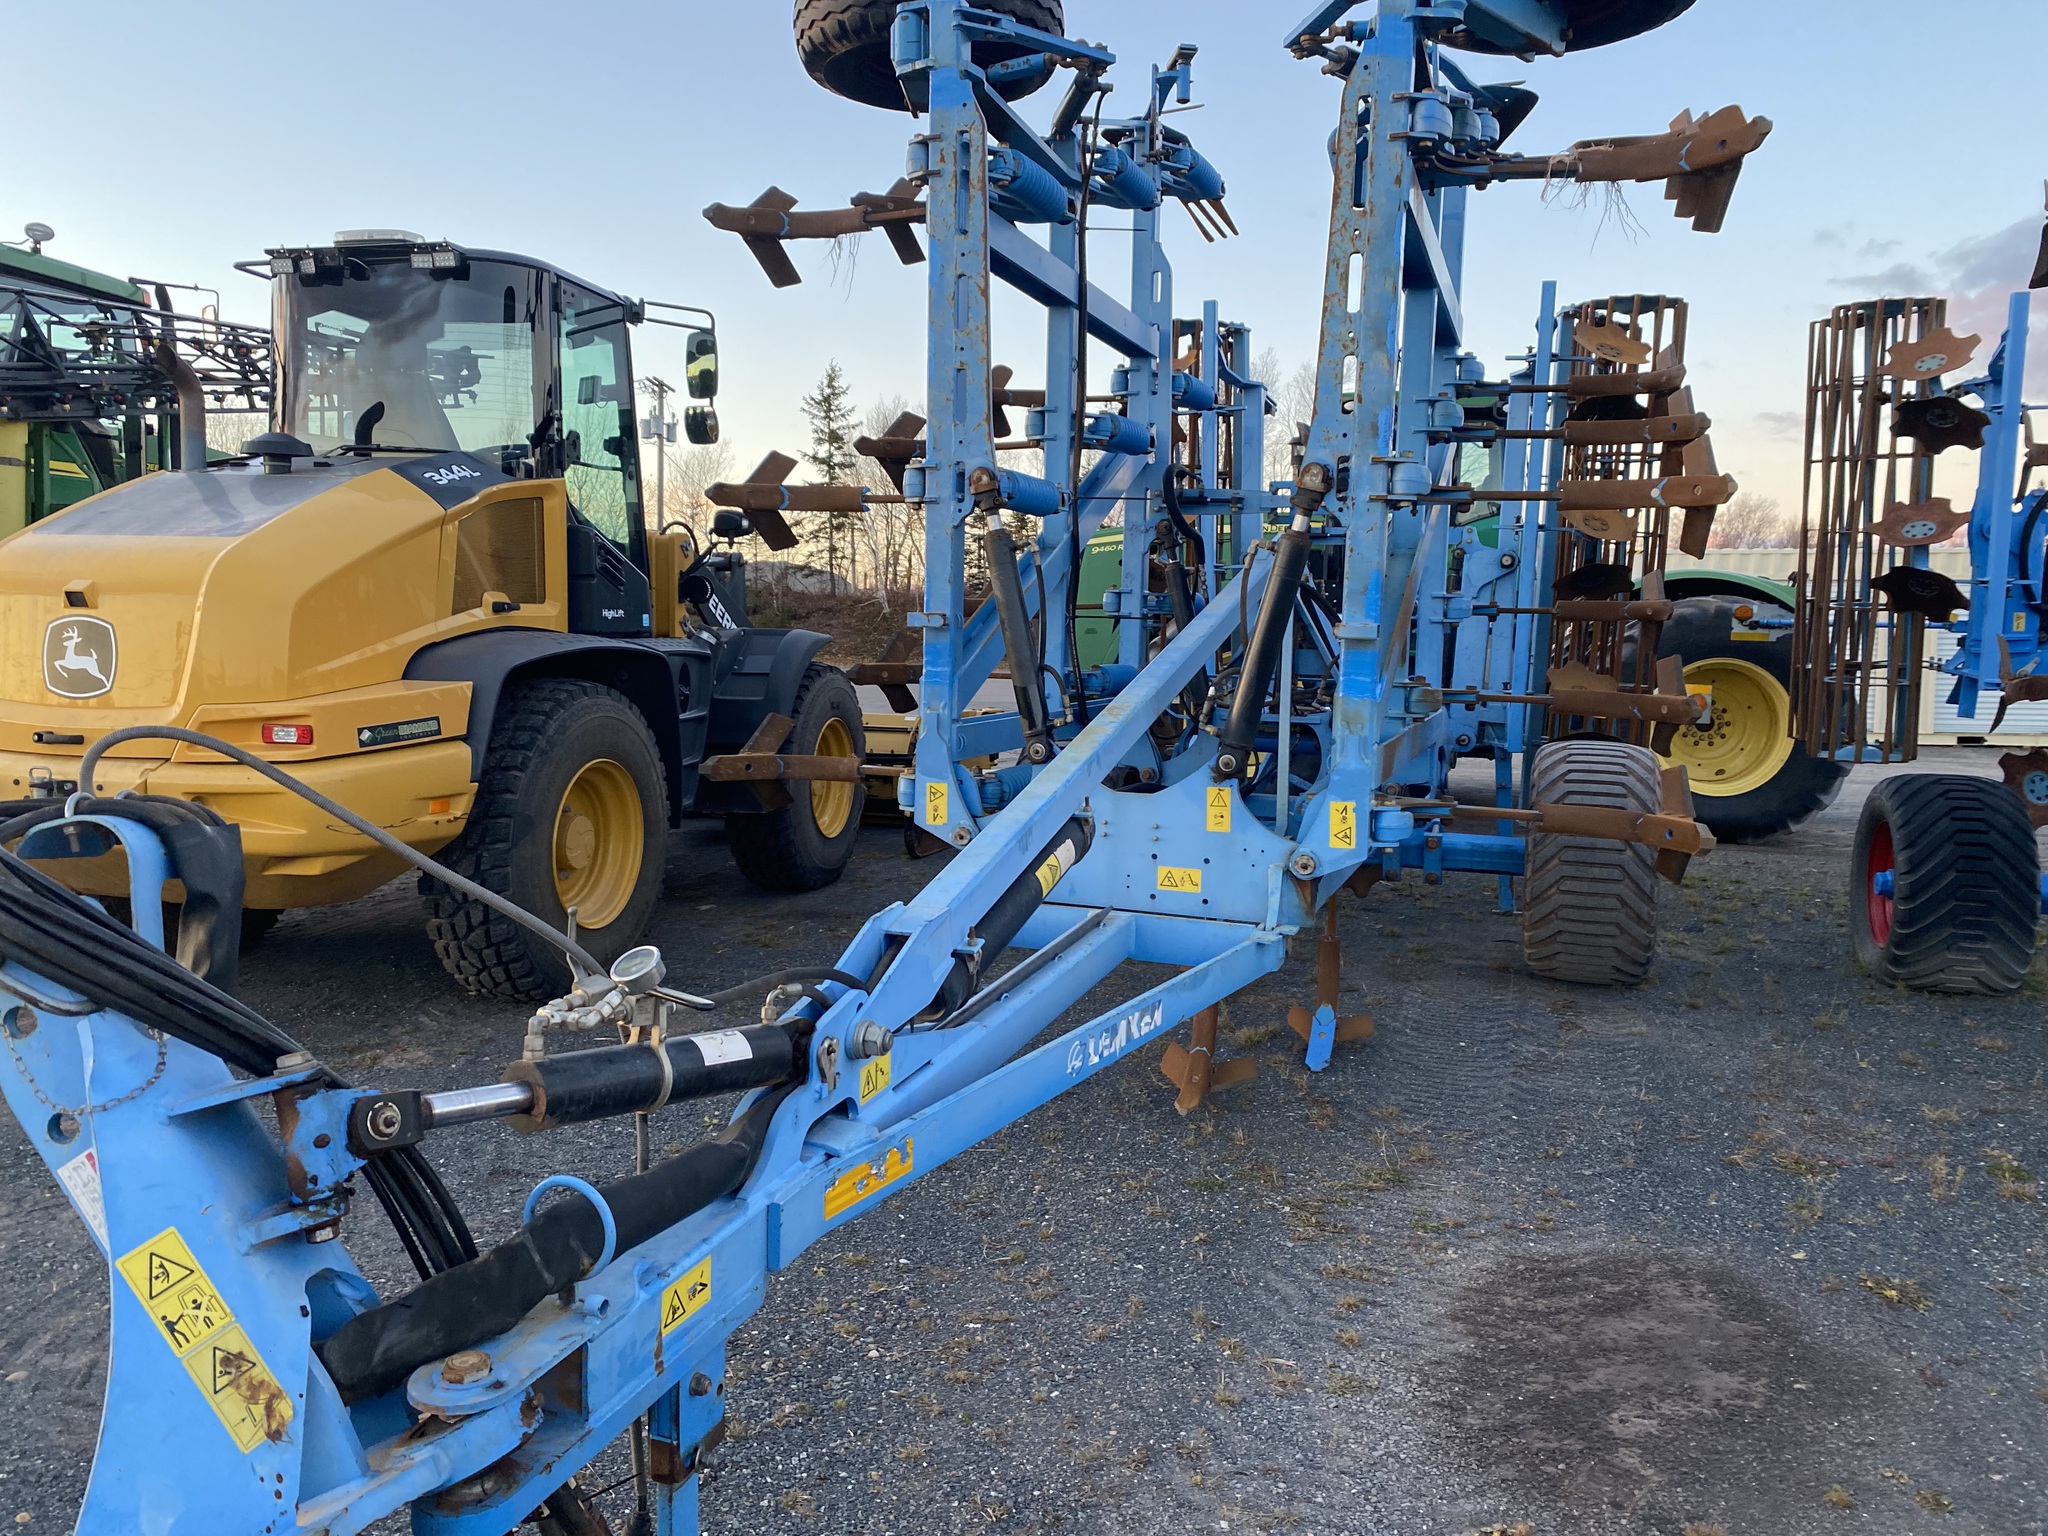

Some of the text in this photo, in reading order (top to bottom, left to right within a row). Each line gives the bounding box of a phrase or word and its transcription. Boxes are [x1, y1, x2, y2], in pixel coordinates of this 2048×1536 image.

[423, 464, 481, 485] 344L
[1091, 544, 1117, 555] 9460
[602, 608, 625, 620] HighLift
[398, 720, 438, 735] DIAMOND
